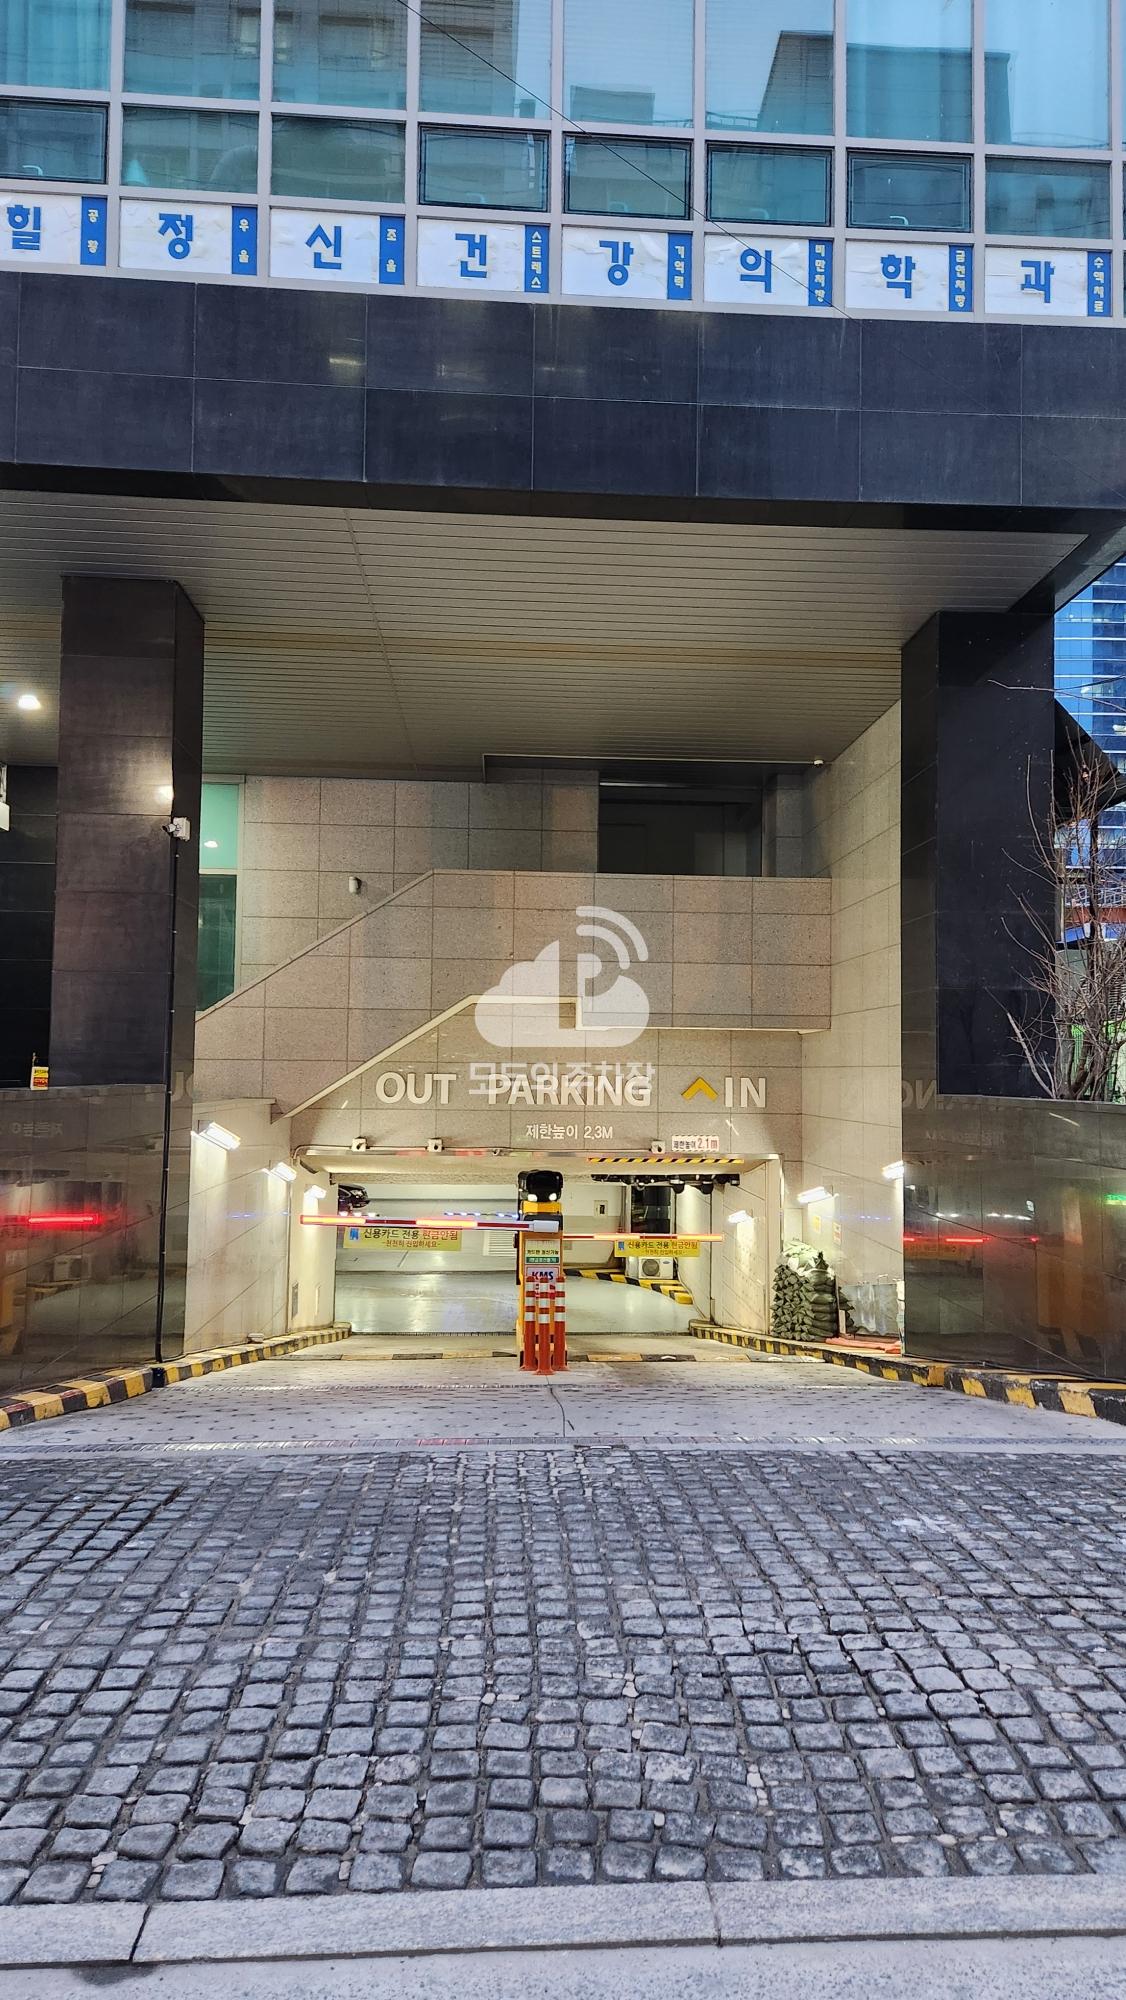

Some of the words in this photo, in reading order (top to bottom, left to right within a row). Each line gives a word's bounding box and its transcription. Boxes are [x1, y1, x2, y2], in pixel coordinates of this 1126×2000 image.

[87, 209, 99, 254] 공황
[238, 218, 250, 264] 우울
[386, 228, 397, 273] 조울
[6, 204, 41, 250] 힐
[157, 213, 194, 260] 정
[305, 224, 342, 270] 신
[455, 233, 488, 278] 건
[599, 240, 635, 286] 강
[739, 248, 772, 293] 의
[880, 254, 916, 299] 학
[1020, 260, 1055, 304] 과
[531, 231, 542, 289] 스트레스
[375, 1071, 457, 1105] OUT
[488, 1073, 651, 1107] PARKING
[725, 1077, 766, 1109] IN
[526, 1123, 578, 1140] 제한높이
[583, 1125, 613, 1140] 2.3M
[673, 1140, 697, 1149] 제한높이
[363, 1228, 402, 1239] 신용카드
[402, 1229, 420, 1240] 전용
[422, 1229, 458, 1240] 현금안됨
[628, 1241, 655, 1249] 신용카드
[656, 1241, 669, 1249] 전용
[531, 1271, 554, 1281] KMS
